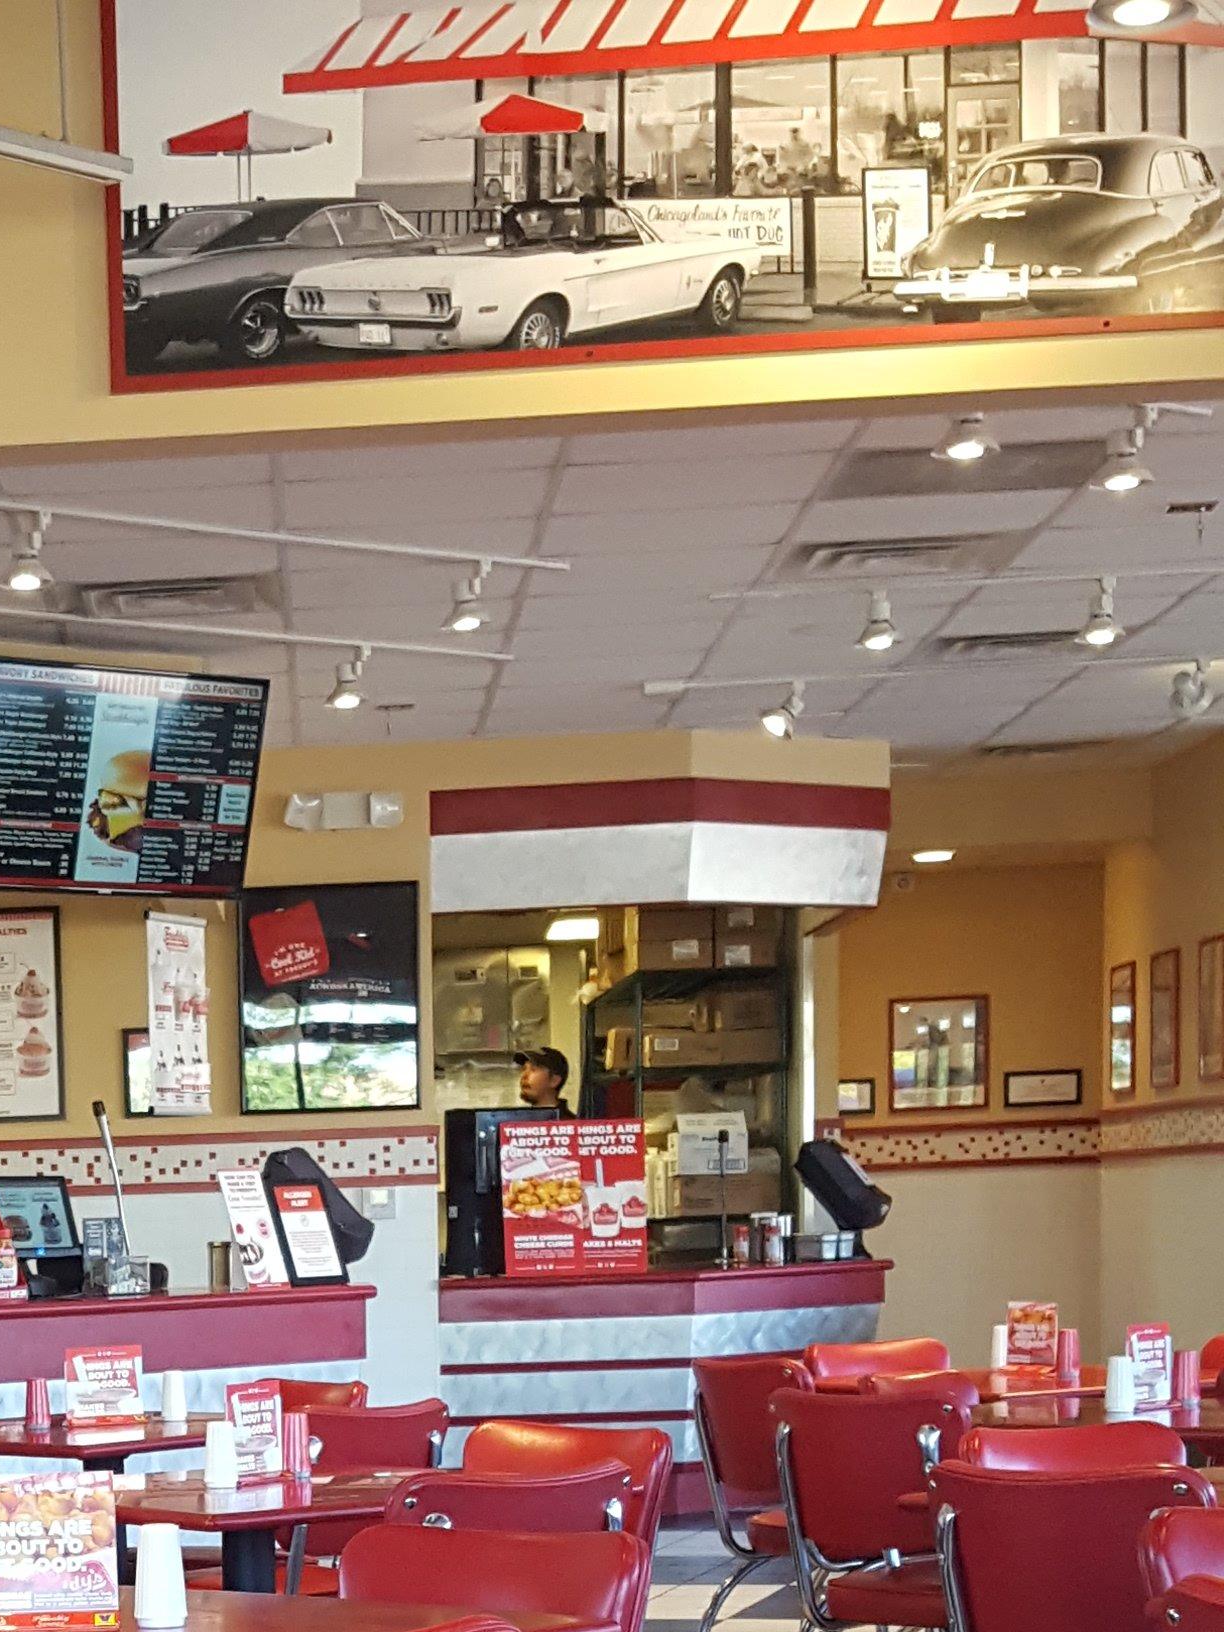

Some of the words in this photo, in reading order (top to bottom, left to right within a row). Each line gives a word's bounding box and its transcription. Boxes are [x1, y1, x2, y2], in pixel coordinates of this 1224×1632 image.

[212, 685, 261, 697] FAVORITES
[503, 1126, 548, 1137] THINGS
[550, 1125, 575, 1136] ARE
[576, 1124, 614, 1135] HINGS
[616, 1123, 641, 1134] ARE
[509, 1136, 552, 1148] ABOUT
[554, 1136, 570, 1146] TO
[620, 1135, 637, 1145] TO
[530, 1146, 573, 1157] GOOD.
[600, 1145, 638, 1156] GOOD.
[614, 1239, 643, 1248] MALTS
[84, 1361, 112, 1371] HINGS
[112, 1360, 133, 1370] ARE
[87, 1370, 115, 1381] BOUT
[116, 1370, 130, 1379] TO
[241, 1413, 261, 1425] BOUT
[262, 1411, 273, 1423] TO
[48, 1519, 93, 1536] ARE
[55, 1538, 84, 1555] TO
